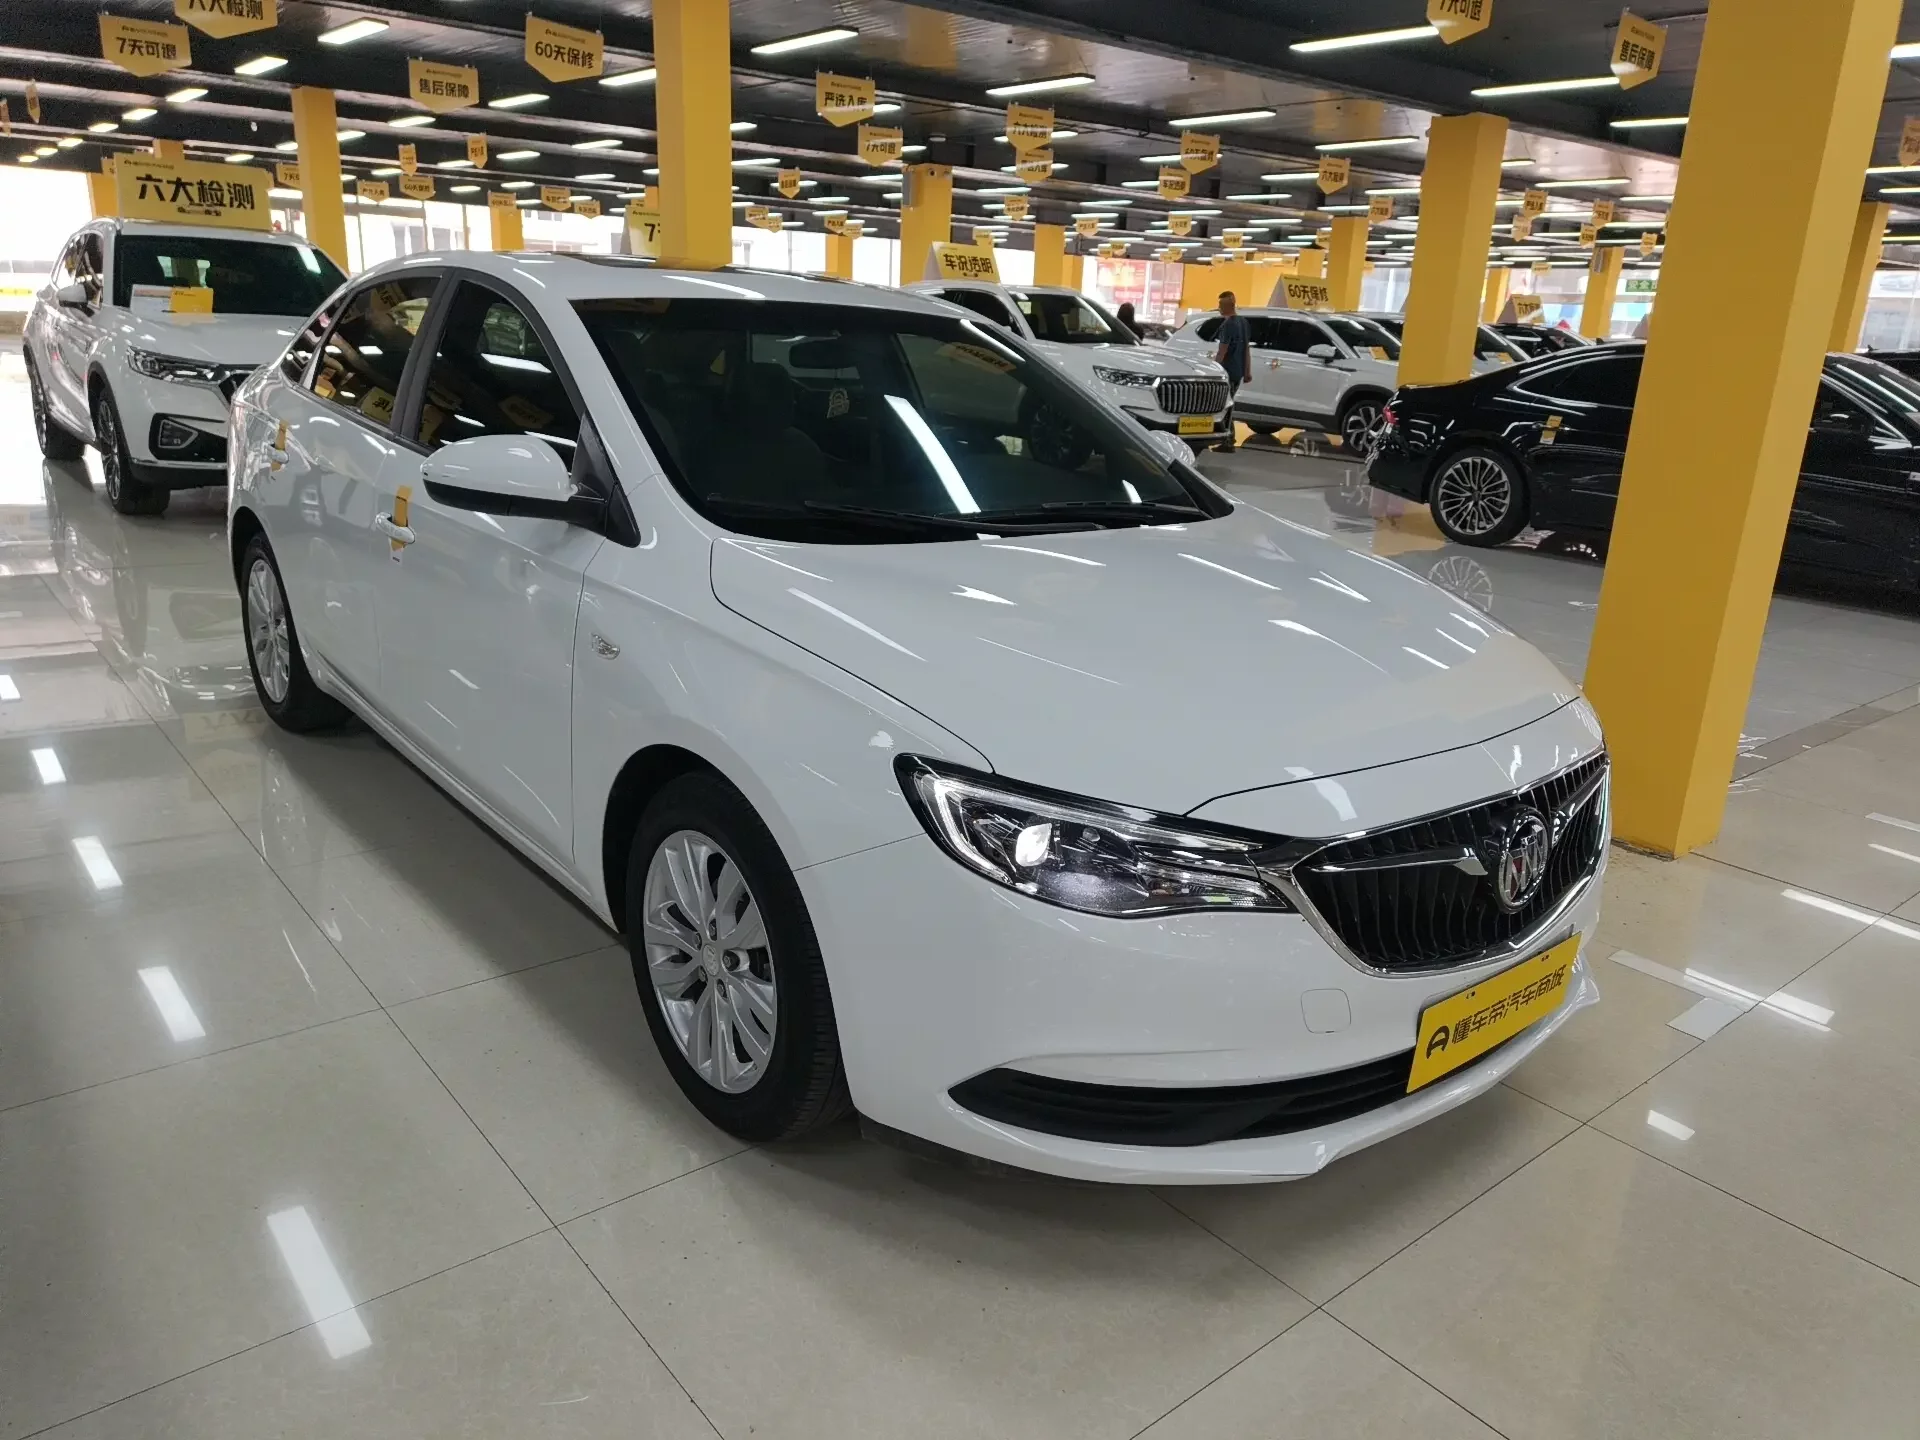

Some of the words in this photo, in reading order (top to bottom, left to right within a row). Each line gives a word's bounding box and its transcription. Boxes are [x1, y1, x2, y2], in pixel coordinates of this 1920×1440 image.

[115, 36, 177, 60] 7天可退
[535, 41, 595, 69] 60天保修
[419, 78, 470, 99] 售后保障
[136, 174, 255, 210] 六大检测
[644, 221, 661, 242] 7
[943, 253, 993, 274] 车况透明
[1288, 284, 1329, 302] 60天保修
[1452, 964, 1567, 1044] 懂车帝汽车商城
